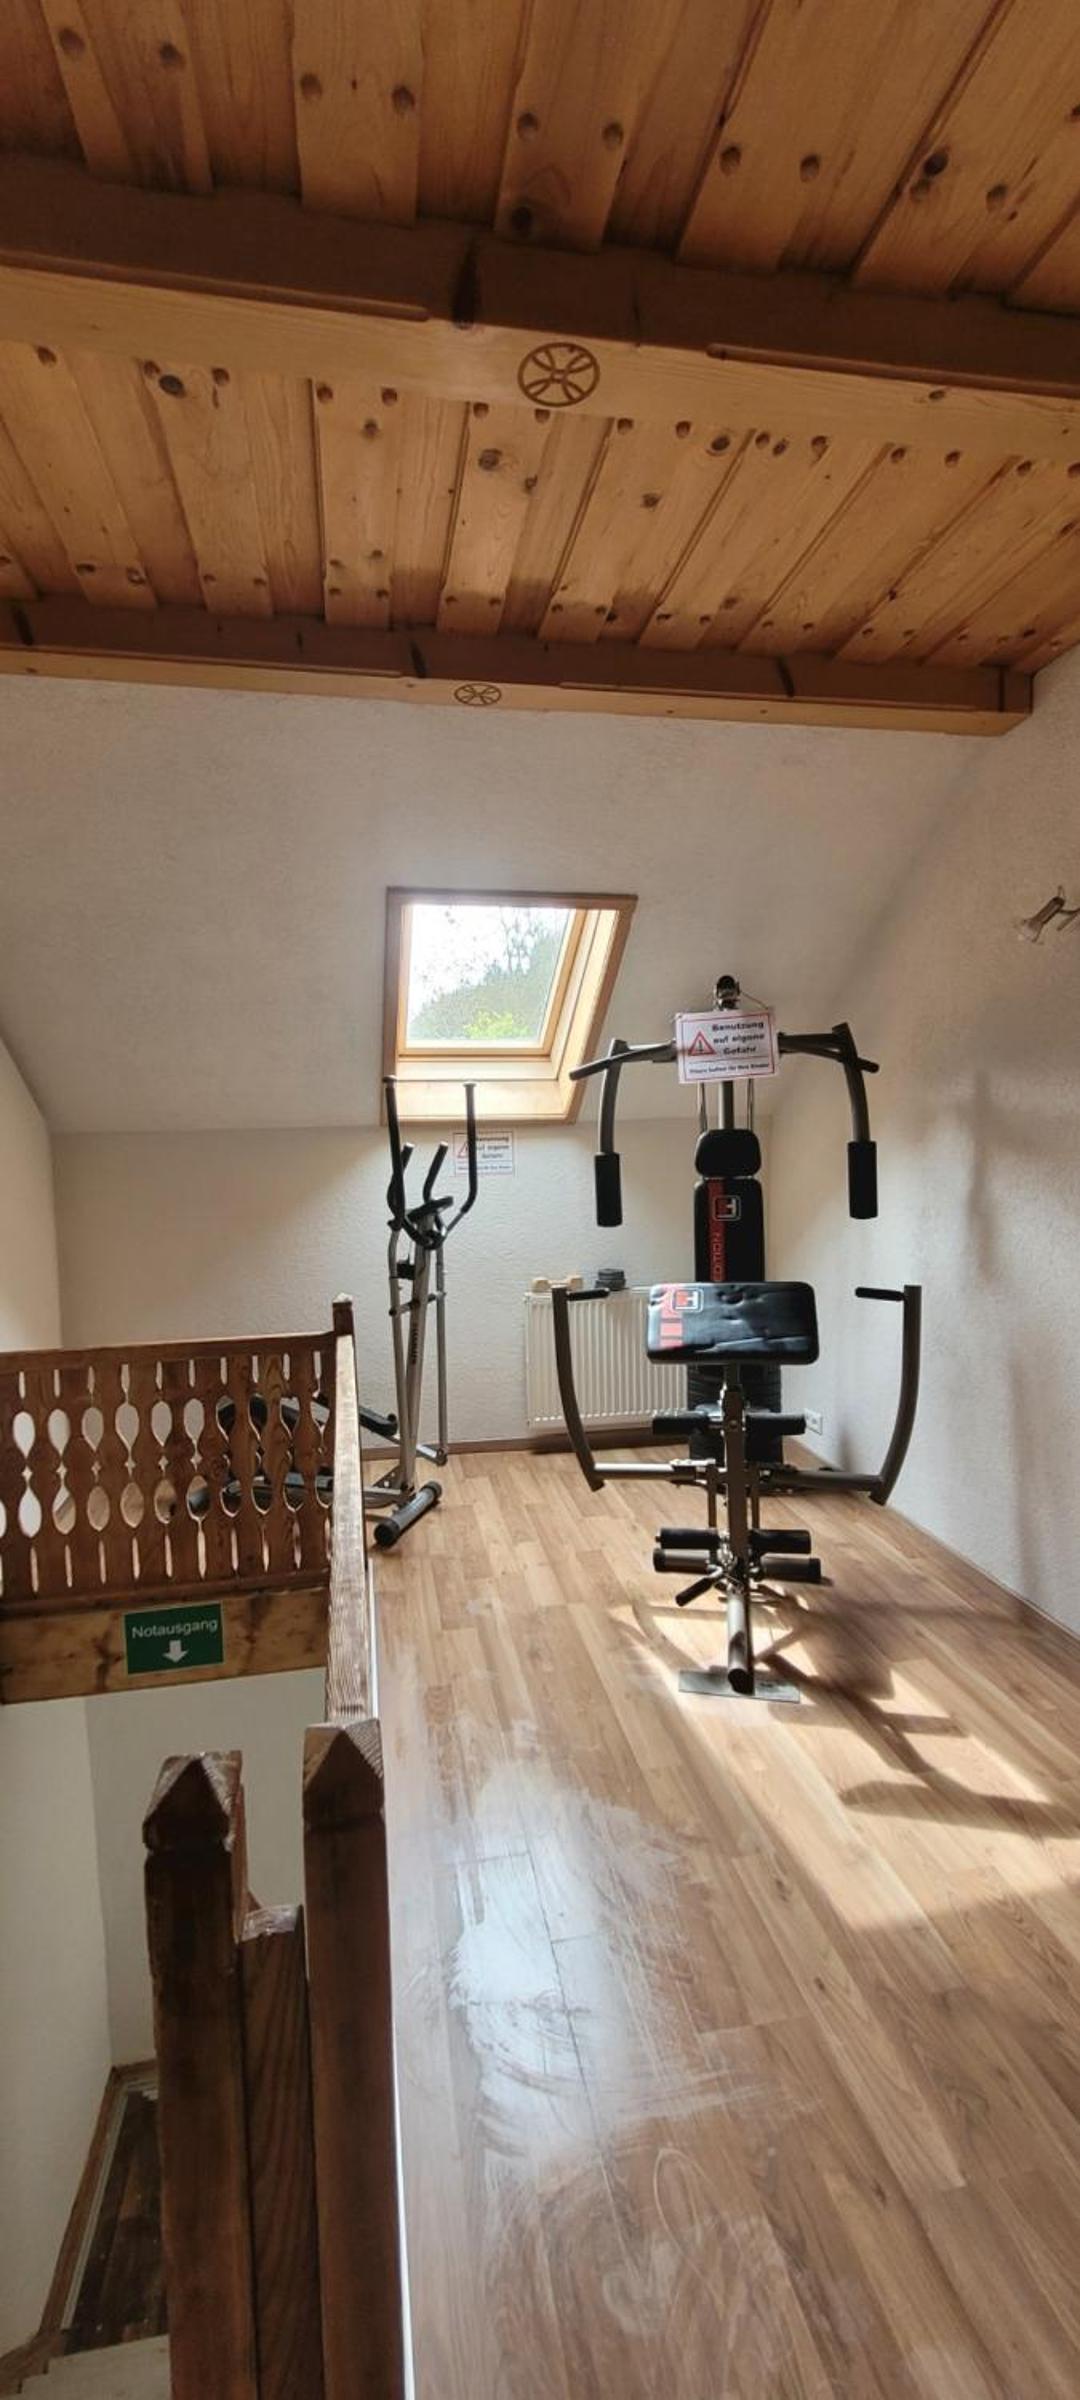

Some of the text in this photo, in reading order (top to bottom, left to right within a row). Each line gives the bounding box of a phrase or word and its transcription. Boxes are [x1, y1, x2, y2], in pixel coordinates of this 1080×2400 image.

[712, 1021, 764, 1031] Benutzung
[713, 1034, 765, 1043] auf eigene
[723, 1047, 756, 1055] Gefahr
[131, 1619, 218, 1639] Notausgang
